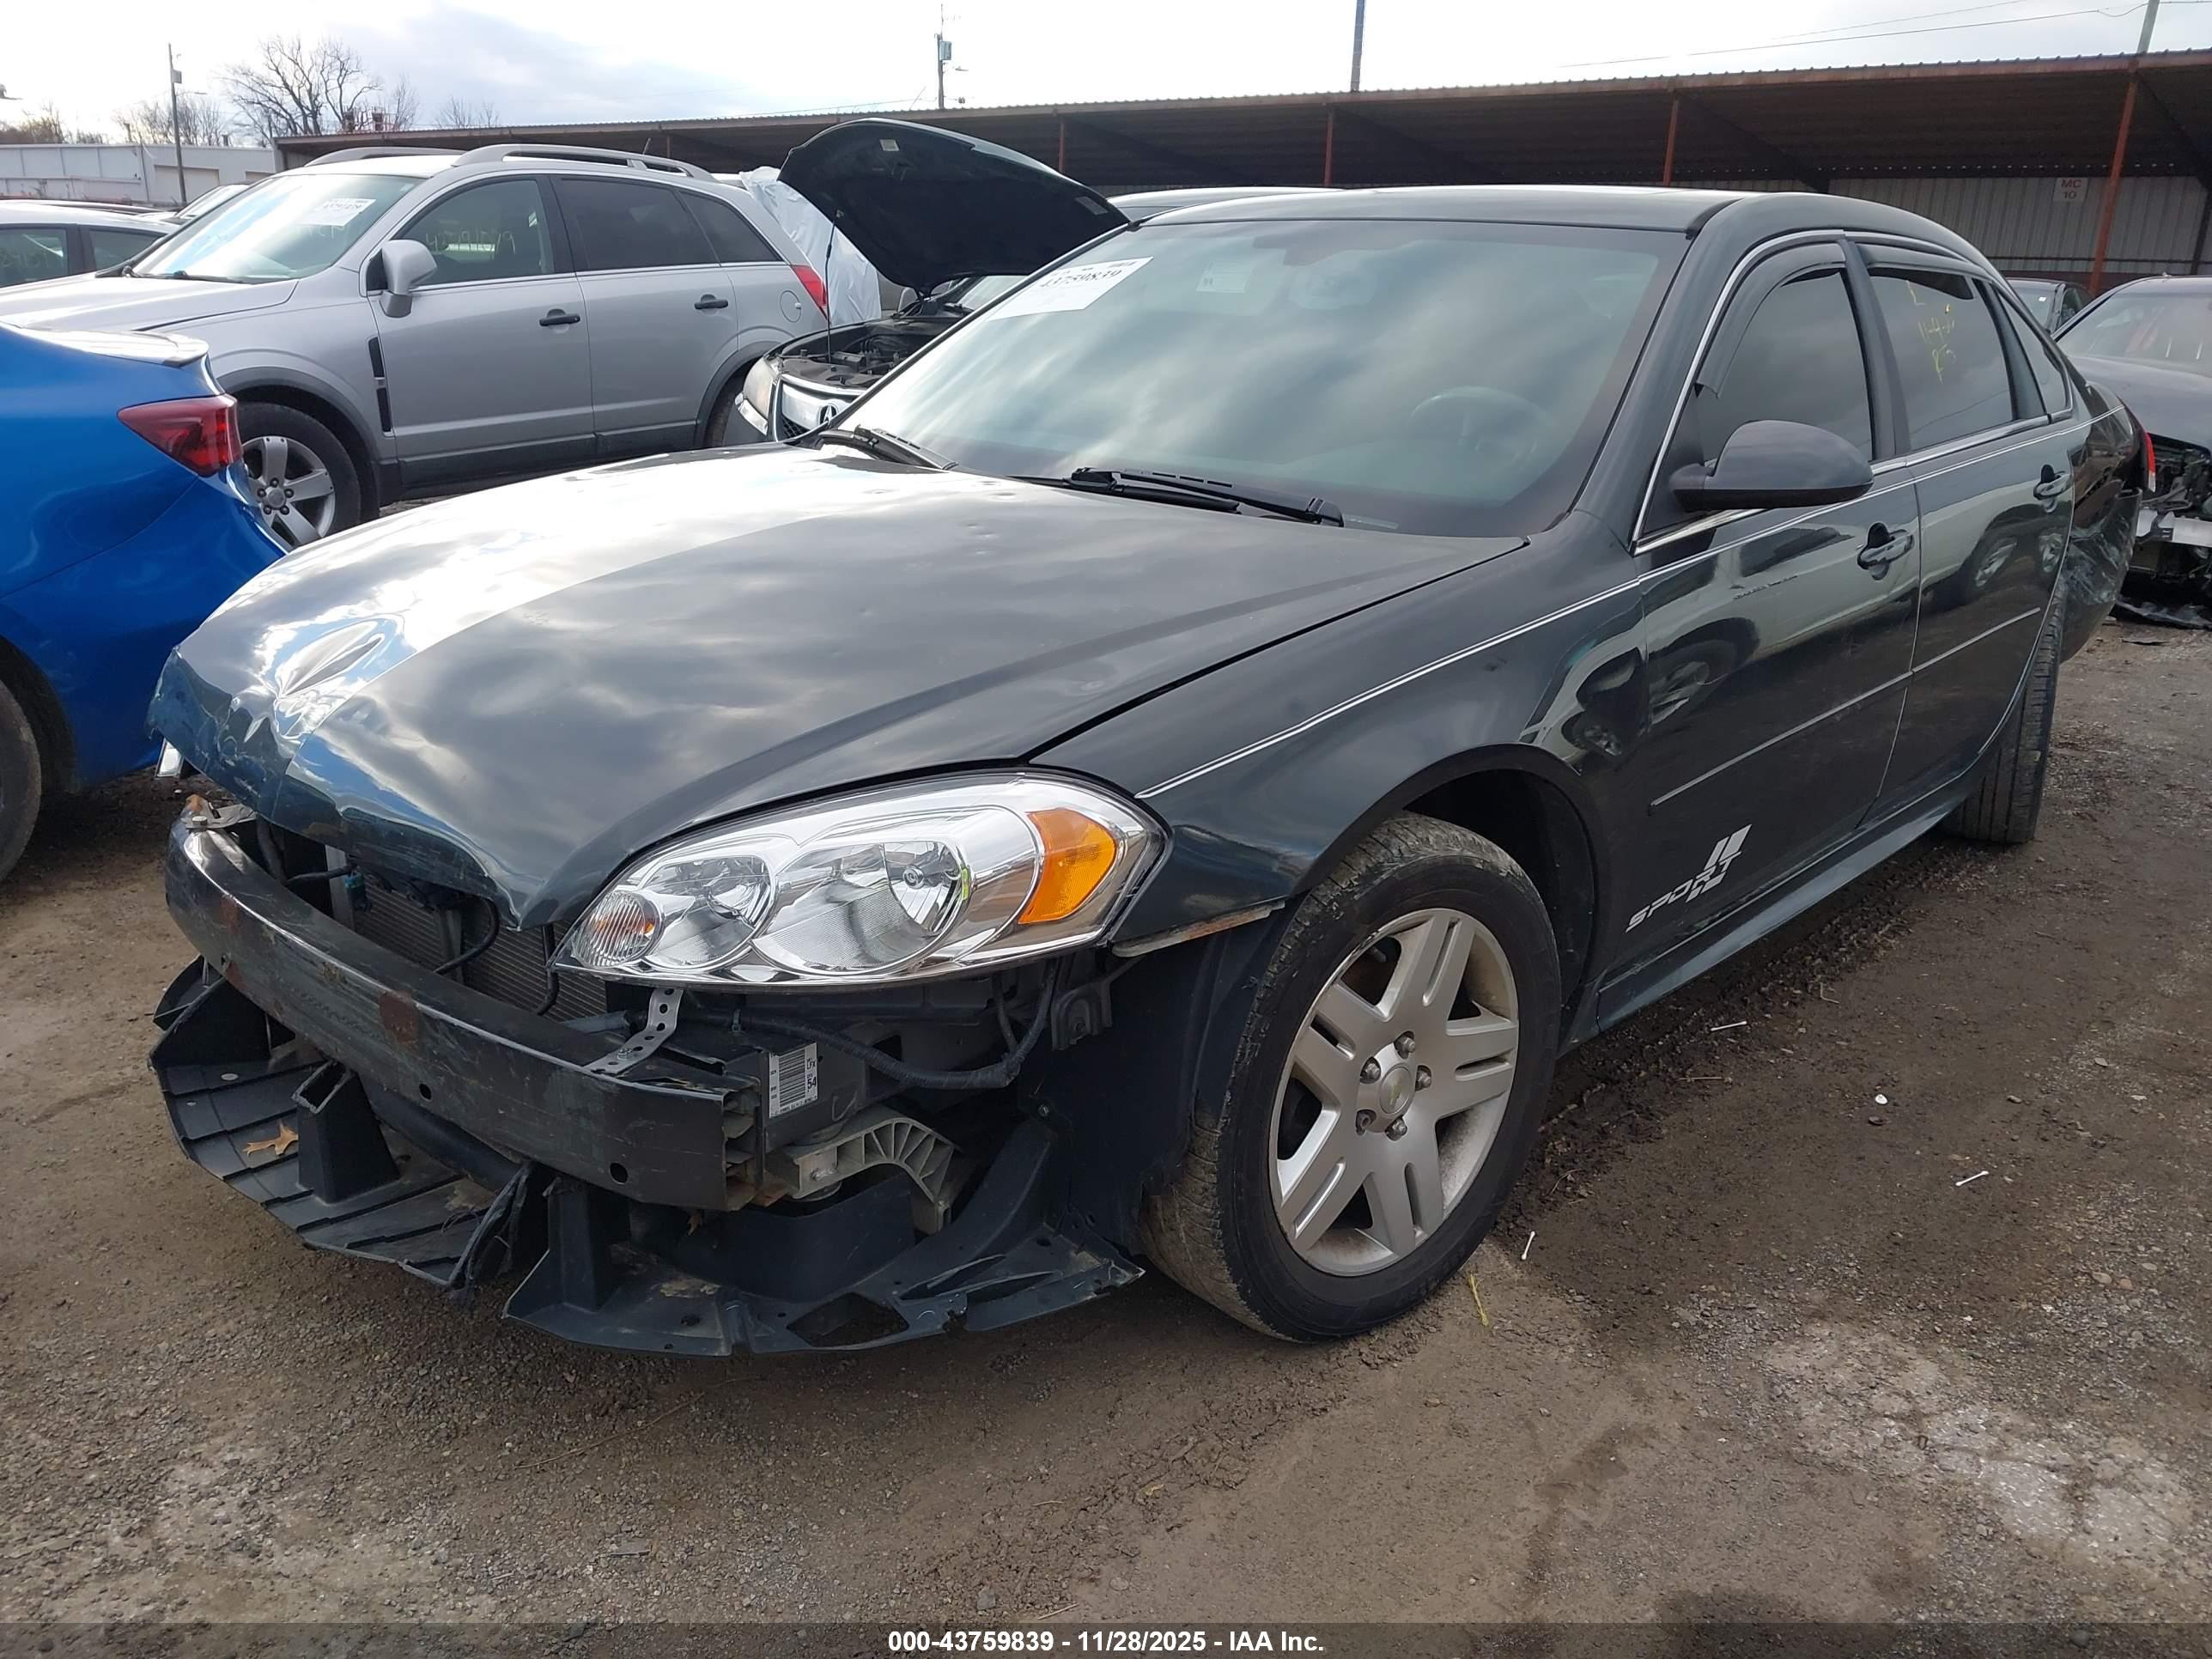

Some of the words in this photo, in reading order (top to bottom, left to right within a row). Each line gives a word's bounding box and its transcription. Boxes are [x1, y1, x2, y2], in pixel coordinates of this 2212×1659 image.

[2061, 179, 2082, 188] MC
[2063, 191, 2077, 199] 10
[1626, 852, 1741, 933] SPORT
[807, 1076, 817, 1090] 54
